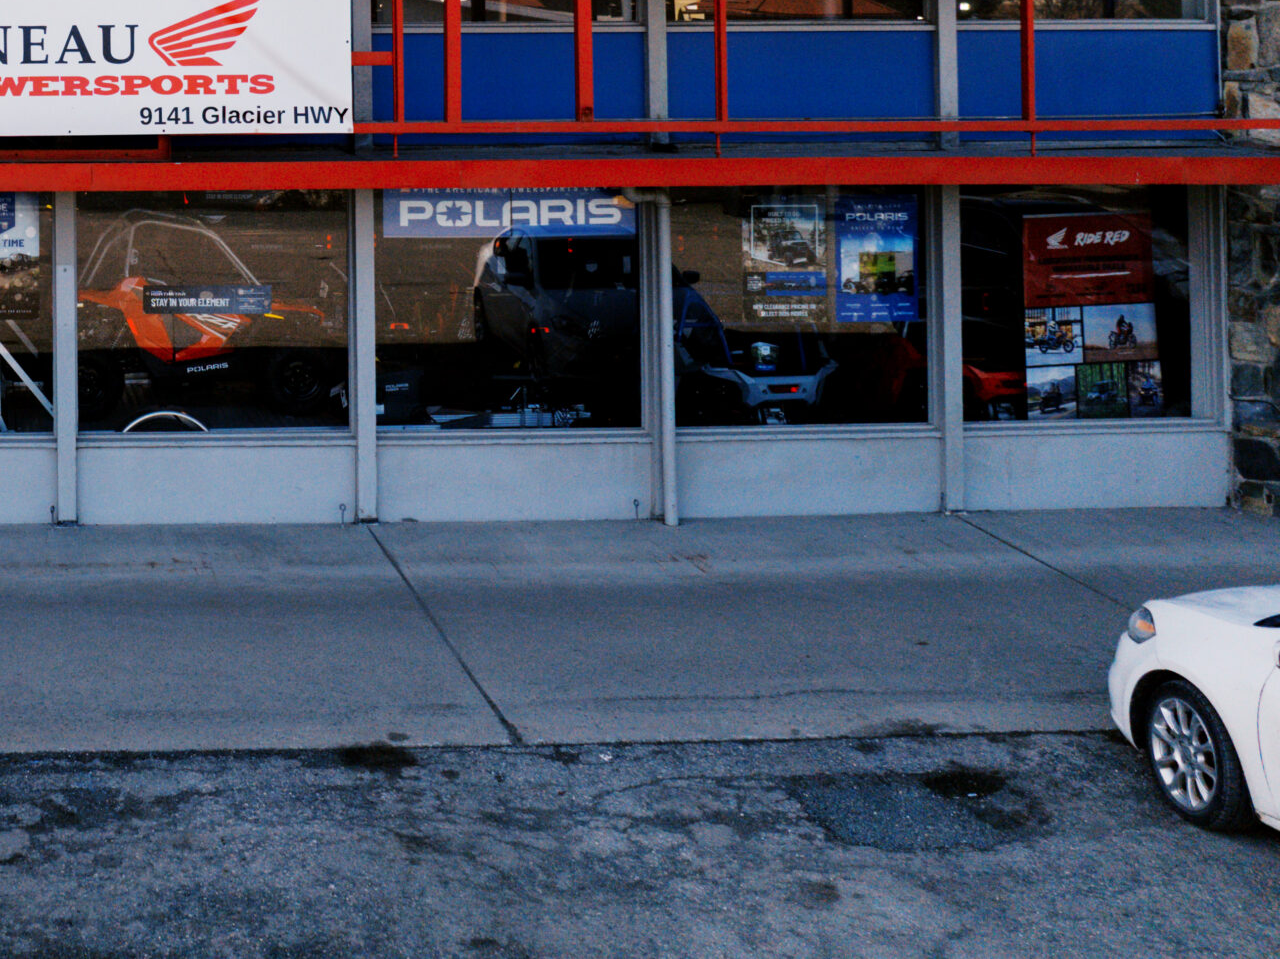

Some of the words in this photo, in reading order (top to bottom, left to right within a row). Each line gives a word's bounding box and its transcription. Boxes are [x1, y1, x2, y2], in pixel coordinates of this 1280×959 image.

[139, 107, 194, 125] 9141
[201, 106, 286, 125] Glacier
[293, 107, 349, 125] HWY
[399, 198, 623, 226] POLARIS
[845, 212, 909, 222] POLARIS
[3, 239, 25, 248] TIME
[1074, 231, 1104, 247] RIDE
[1104, 229, 1131, 247] RED
[151, 298, 168, 307] STAY
[169, 298, 177, 306] IN
[178, 298, 197, 306] YOUR
[198, 298, 230, 306] ELEMENT
[186, 362, 229, 374] POLARIS
